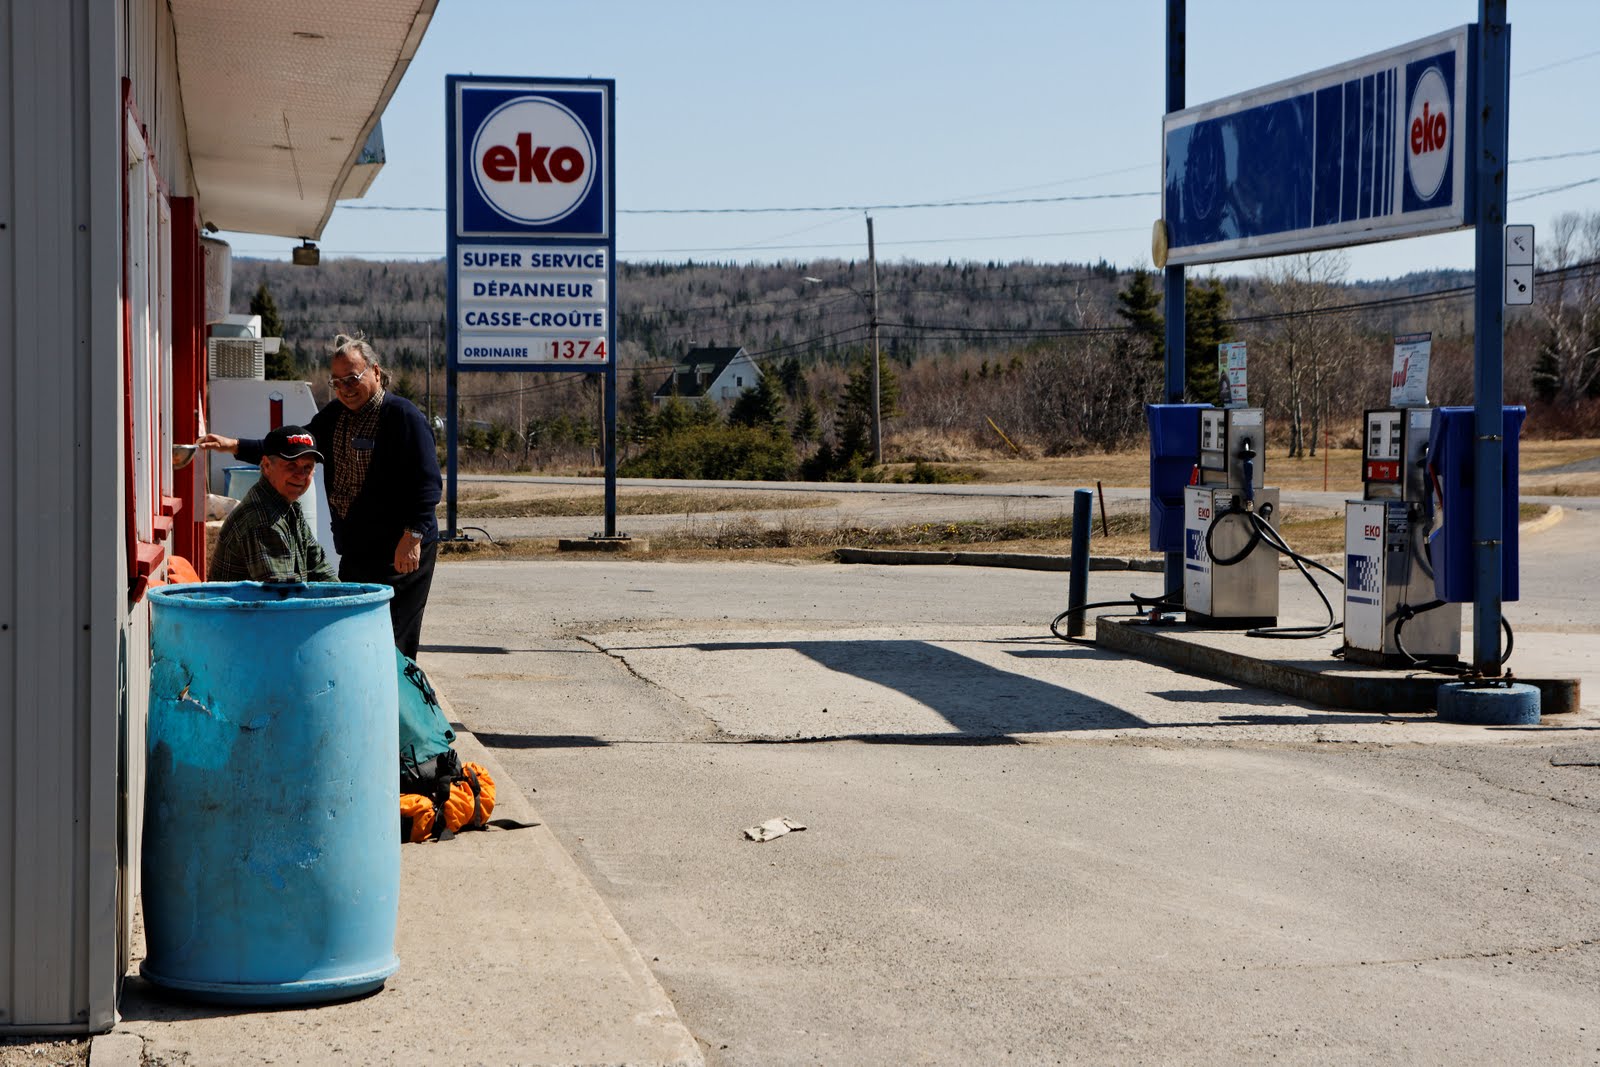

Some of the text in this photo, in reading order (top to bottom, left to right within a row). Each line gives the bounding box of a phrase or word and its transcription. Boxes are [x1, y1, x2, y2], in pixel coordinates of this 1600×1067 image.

[1411, 101, 1447, 155] eko
[482, 132, 585, 183] eko
[463, 252, 604, 268] SUPER SERVICE
[473, 280, 593, 298] DÉPANNEUR
[465, 310, 602, 327] CASSE-CROÛTE
[464, 341, 606, 359] ORDINAIRE 1374
[1198, 507, 1210, 518] EKO
[1364, 525, 1381, 538] EKO
